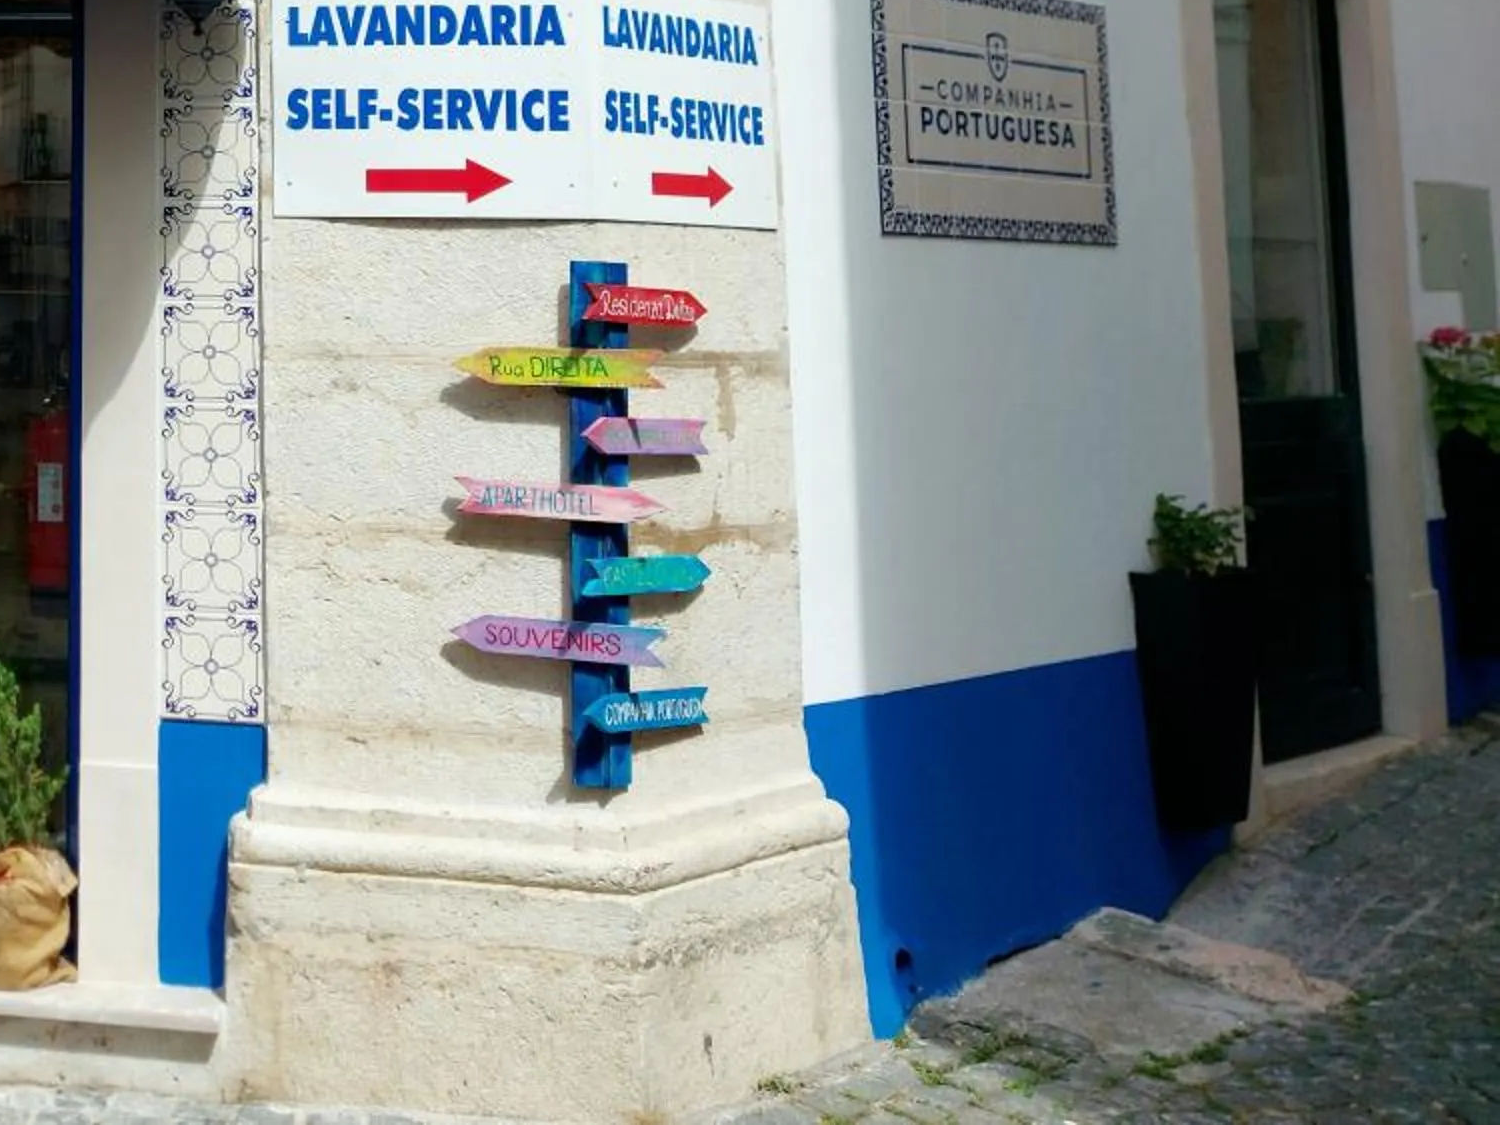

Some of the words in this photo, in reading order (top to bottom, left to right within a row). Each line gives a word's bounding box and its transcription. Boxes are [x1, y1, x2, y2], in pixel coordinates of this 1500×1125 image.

[287, 4, 566, 47] LAVANDARIA
[602, 5, 759, 66] LAVANDARIA
[286, 88, 570, 132] SELF-SERVICE
[936, 78, 1056, 113] COMPANHIA
[605, 89, 765, 146] SELF-SERVICE
[920, 106, 1077, 149] PORTUGUESA
[489, 354, 525, 377] Rua
[485, 623, 622, 656] SOUVENIRS
